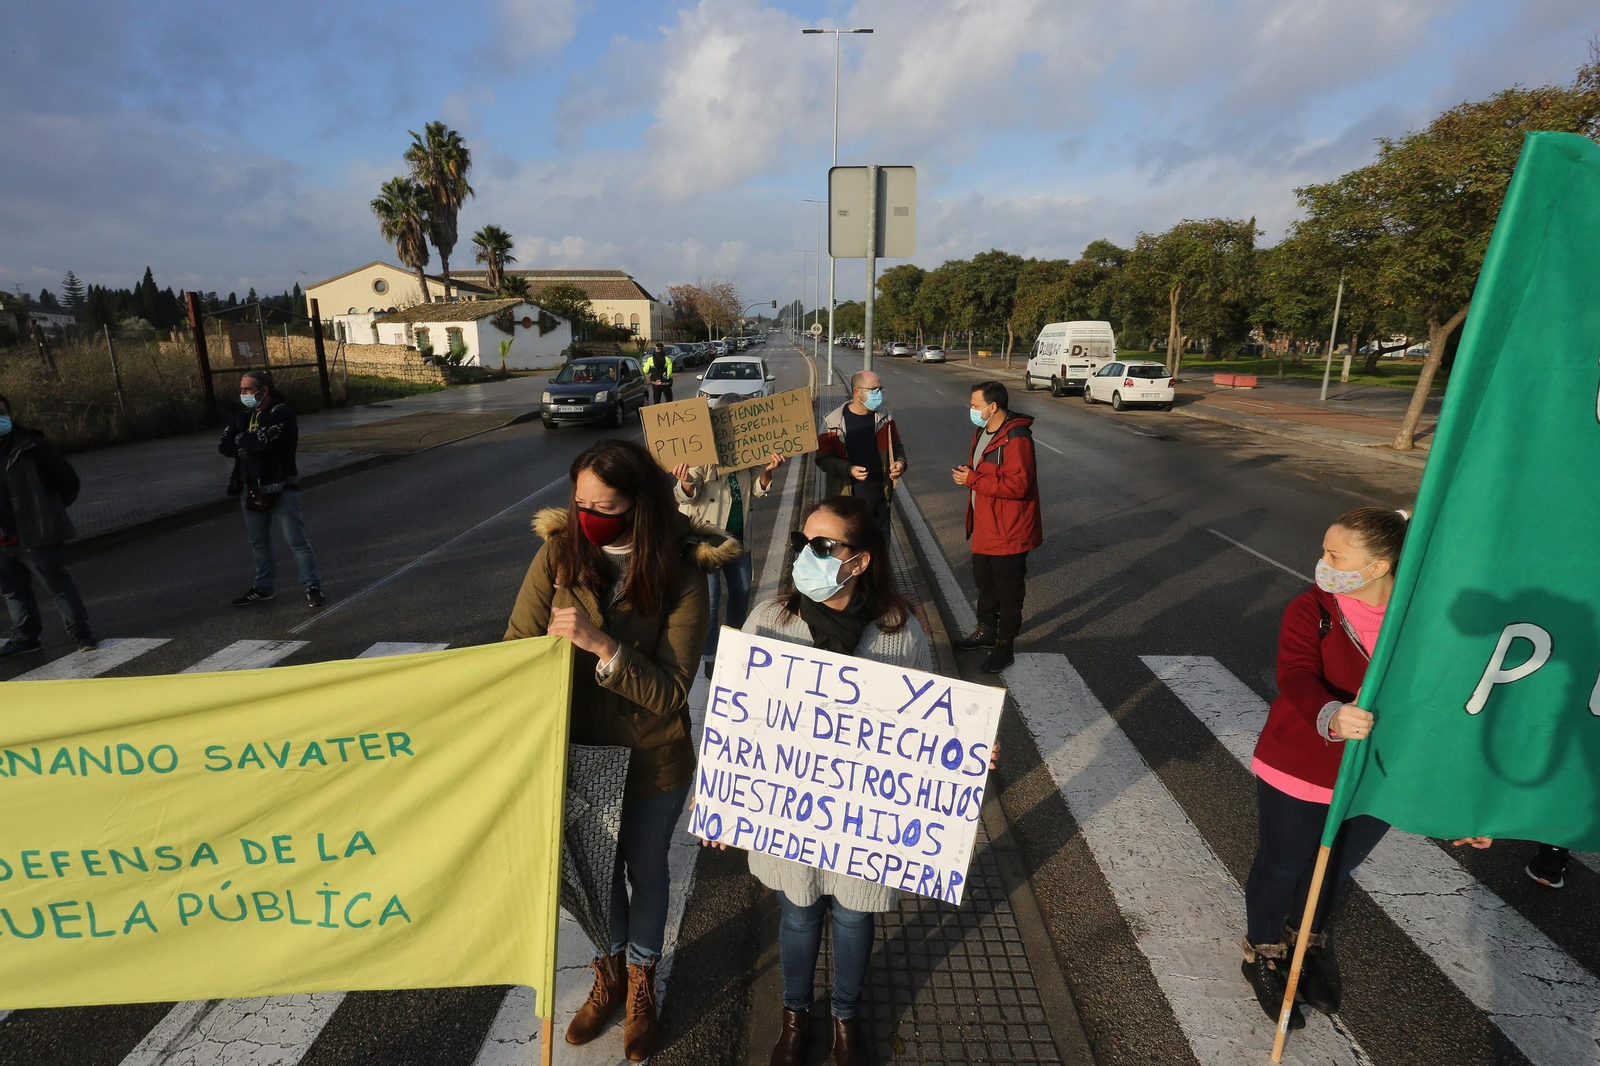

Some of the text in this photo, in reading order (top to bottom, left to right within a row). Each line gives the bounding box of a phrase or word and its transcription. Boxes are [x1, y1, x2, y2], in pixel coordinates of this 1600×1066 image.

[657, 403, 697, 427] MÁS
[711, 394, 800, 426] DEFIENDAN LA
[732, 413, 791, 435] ESPECIAL
[654, 434, 703, 460] PTIS
[718, 420, 810, 454] DOTÁNDOLA DE
[720, 436, 804, 469] RECURSOS
[745, 646, 955, 727] PTIS YA
[703, 726, 767, 771] PARA
[710, 685, 989, 777] ES UN DERECHOS
[204, 731, 415, 772] SAVATER
[699, 765, 945, 856] NUESTROS HIJOS
[240, 834, 296, 865] DE
[317, 831, 377, 862] LA
[692, 803, 964, 905] NO PUEDEN ESPERAR
[0, 880, 411, 939] UELA PÚBLICA
